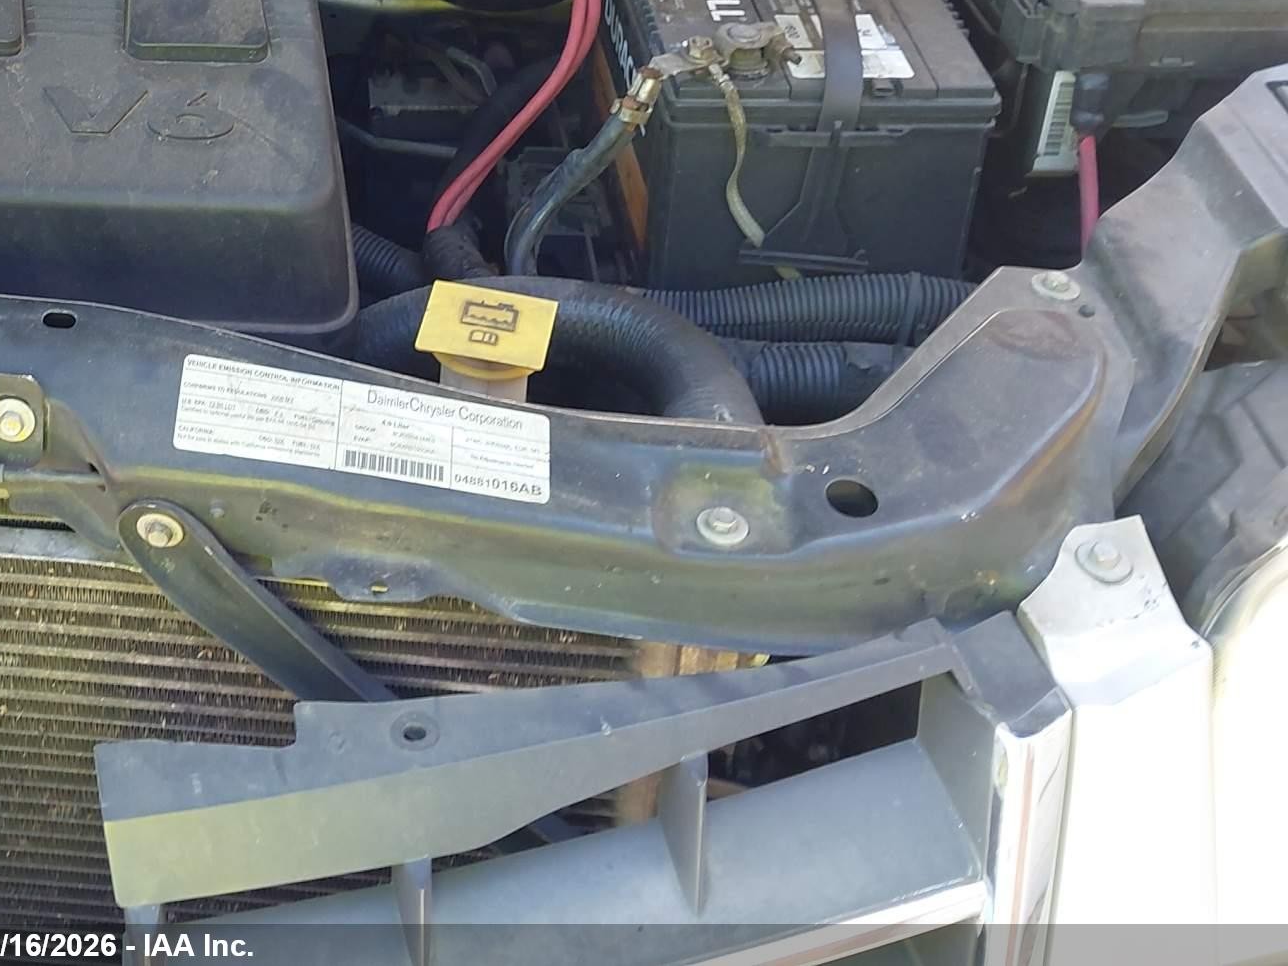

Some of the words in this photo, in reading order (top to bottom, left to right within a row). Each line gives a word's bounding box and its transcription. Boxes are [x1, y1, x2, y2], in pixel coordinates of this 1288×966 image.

[42, 85, 236, 142] V6
[367, 389, 455, 418] DaimlerChrysler
[458, 406, 523, 430] Corporation
